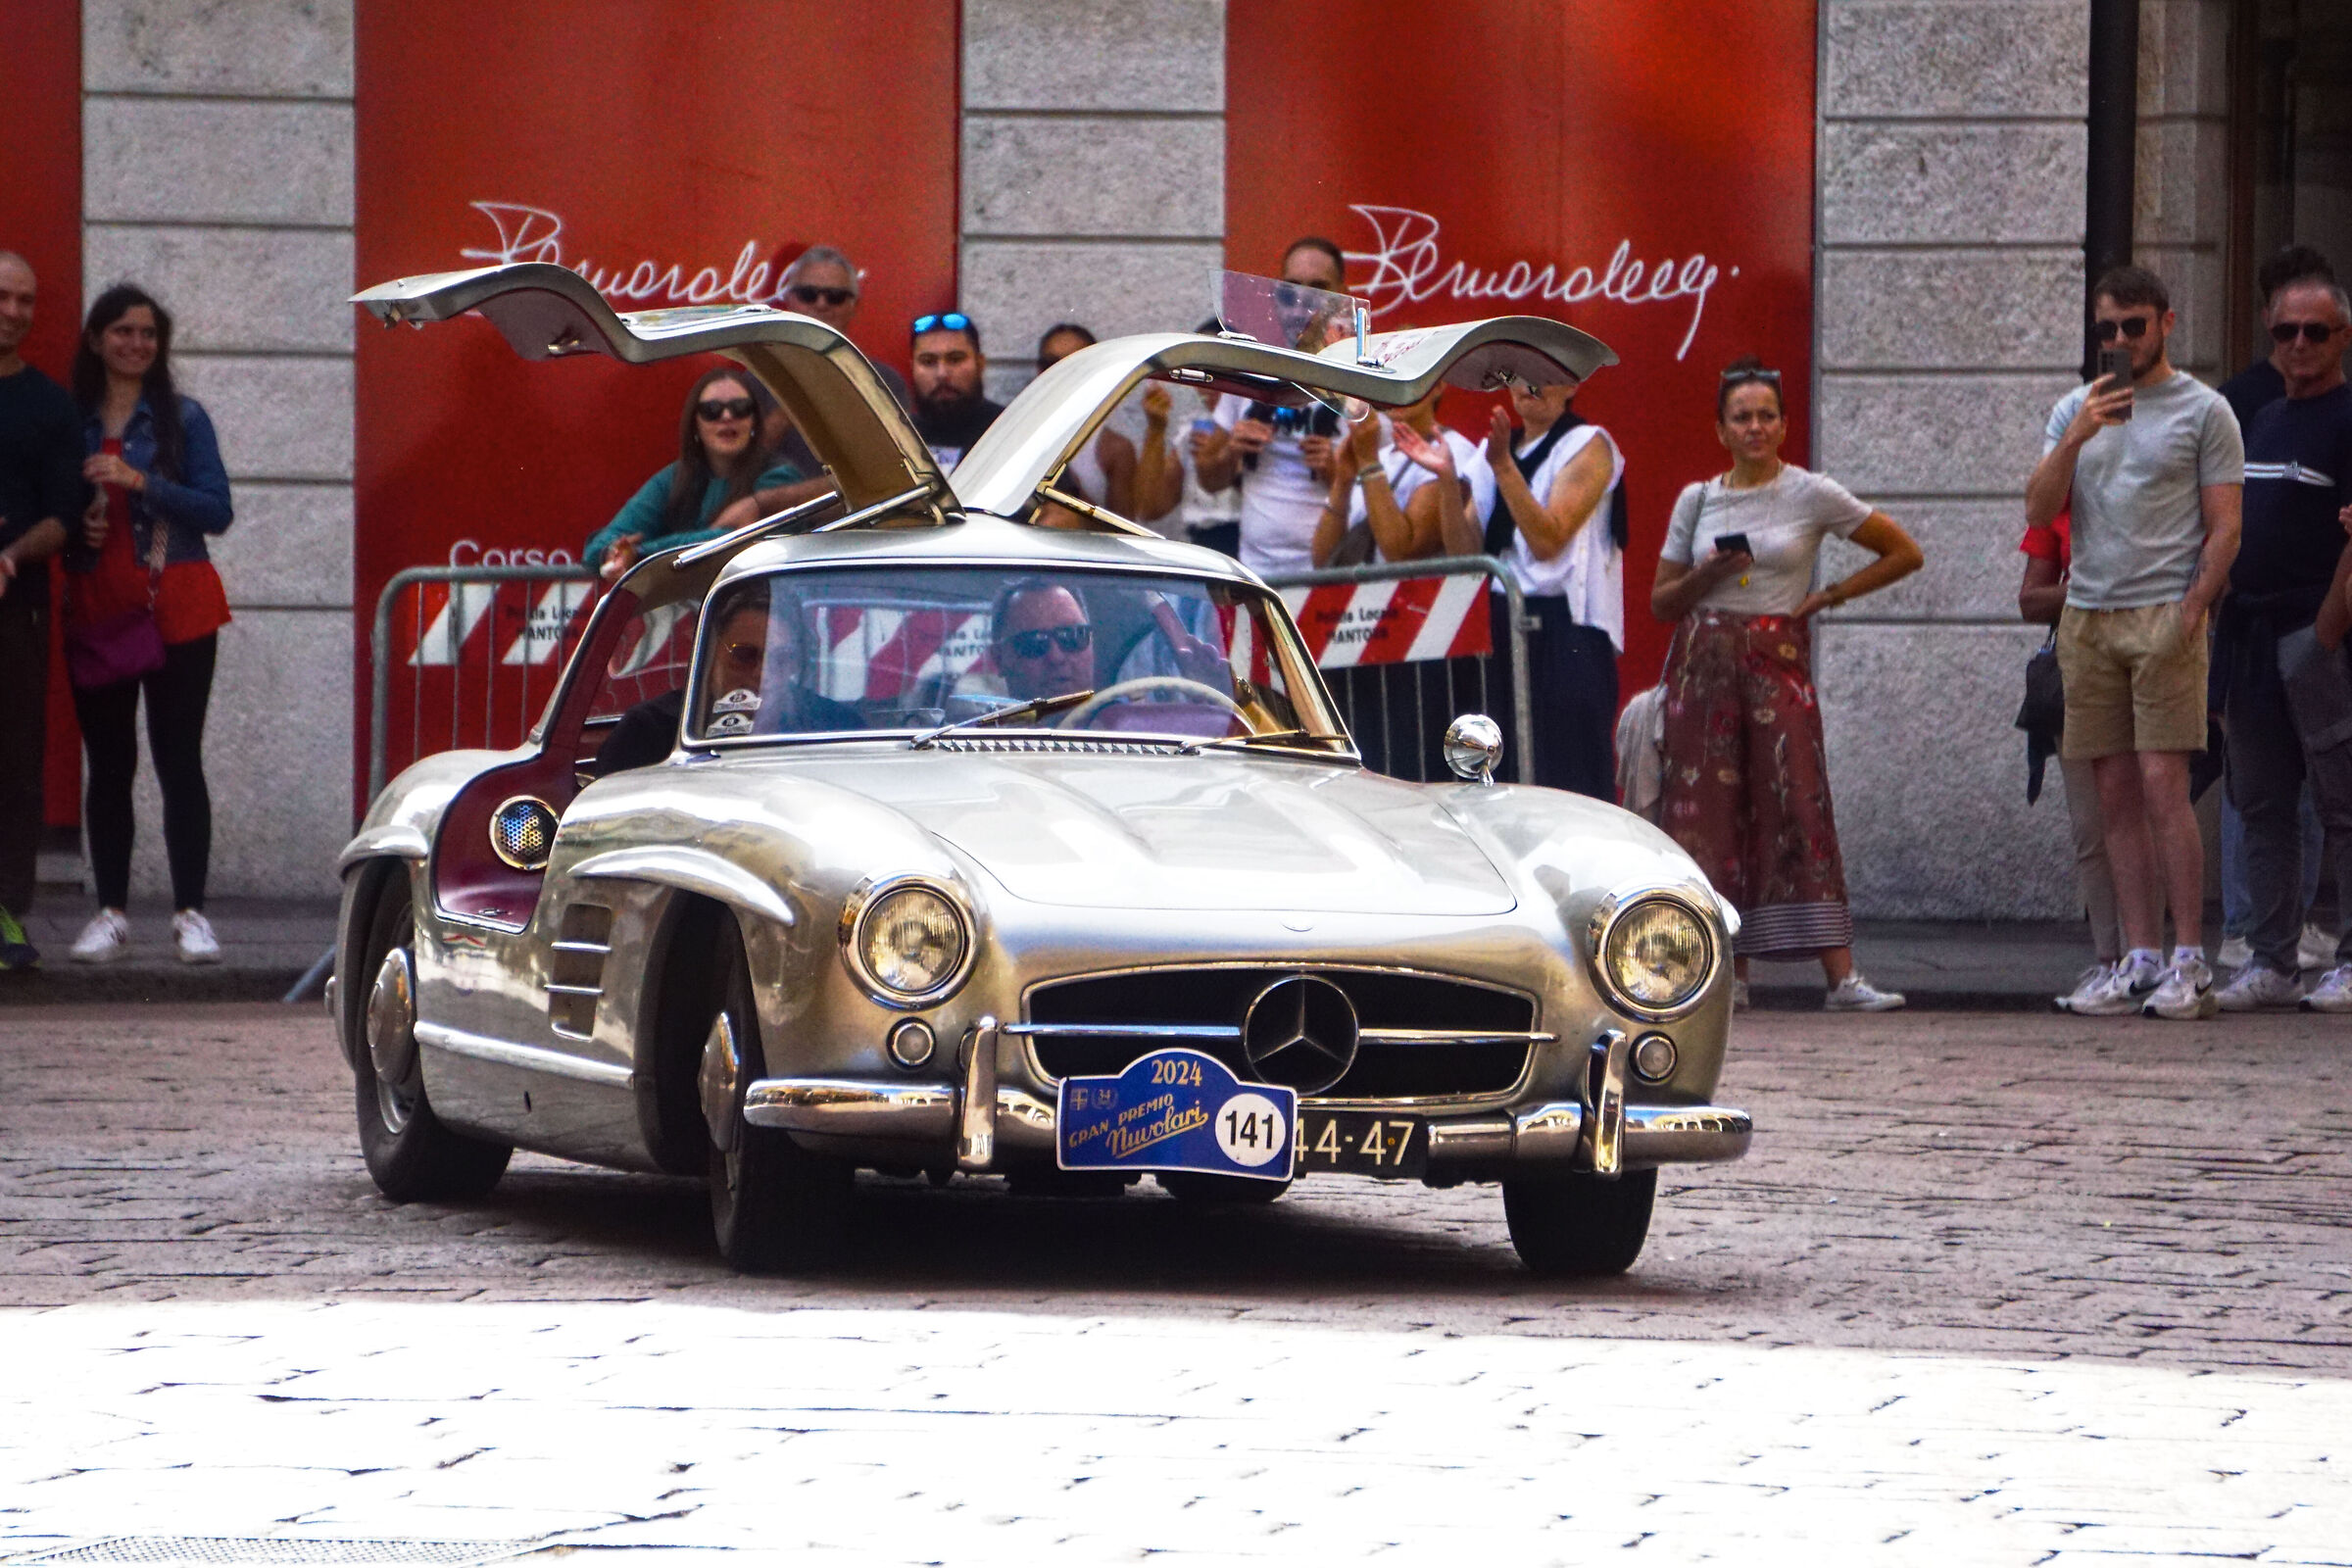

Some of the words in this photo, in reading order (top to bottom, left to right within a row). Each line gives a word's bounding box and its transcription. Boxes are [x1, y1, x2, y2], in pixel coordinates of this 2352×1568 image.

[1151, 1059, 1202, 1087] 2024
[1069, 1119, 1108, 1149] GRAN
[1118, 1093, 1174, 1124] PREMIO
[1105, 1100, 1209, 1158] Nuvolari
[1225, 1109, 1274, 1150] 141
